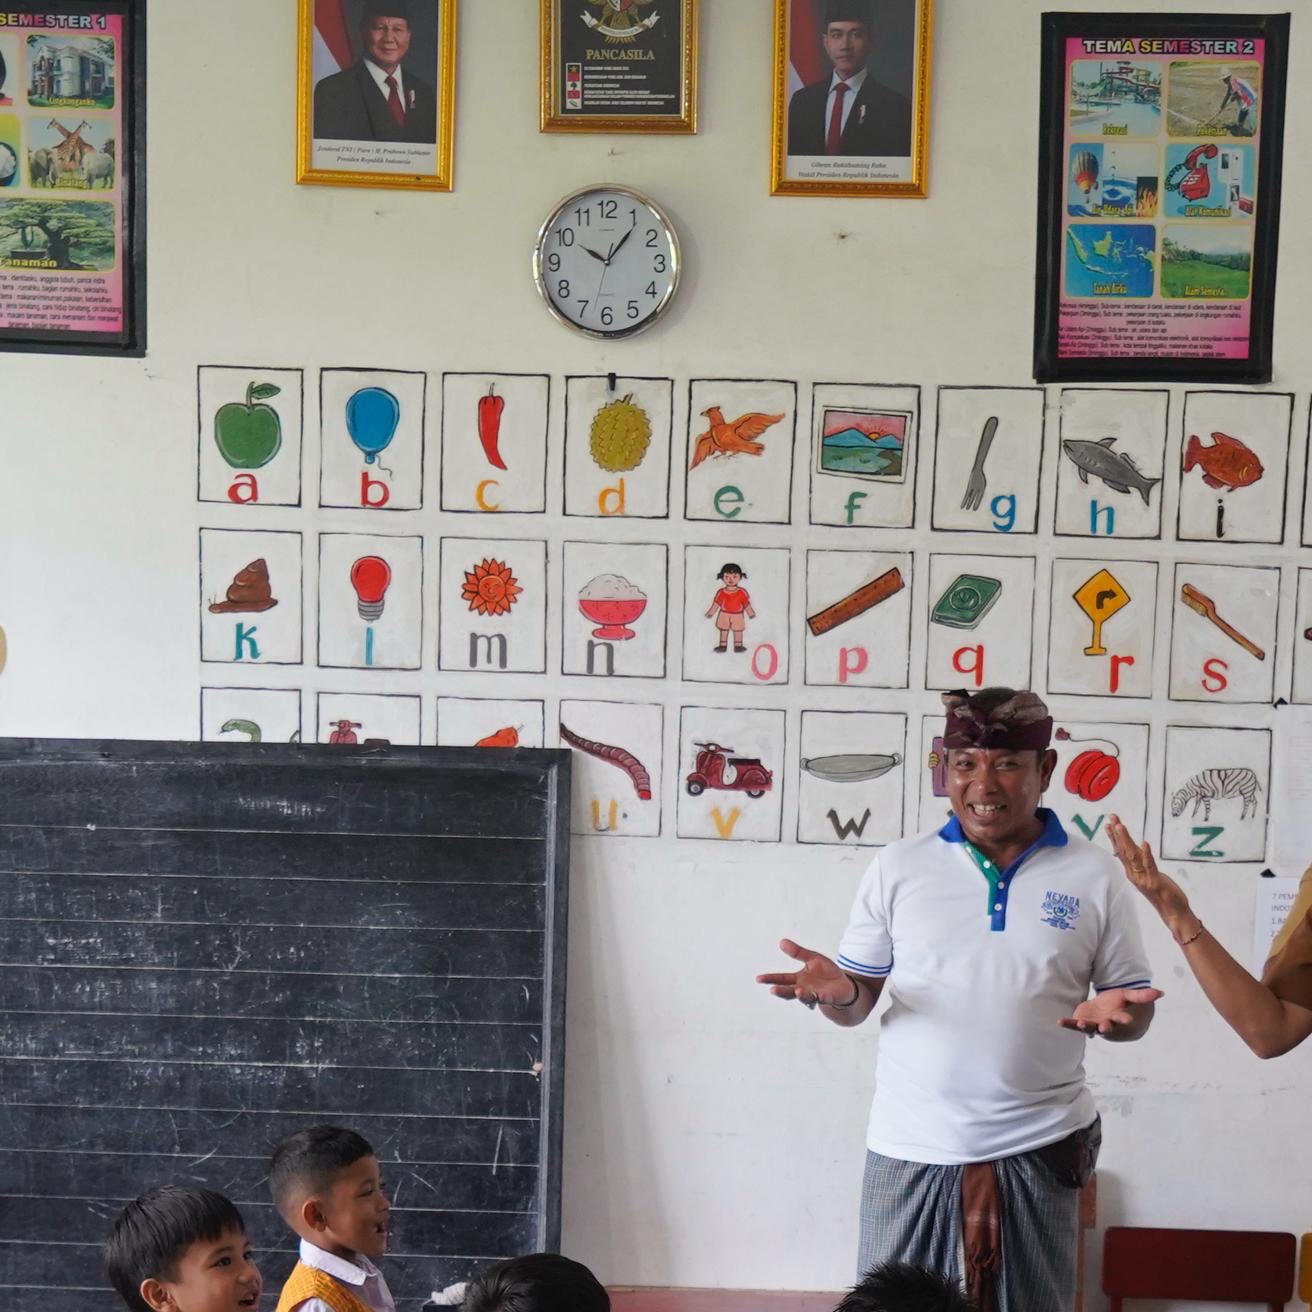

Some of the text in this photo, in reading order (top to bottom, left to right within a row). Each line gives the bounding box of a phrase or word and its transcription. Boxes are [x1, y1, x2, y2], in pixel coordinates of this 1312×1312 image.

[97, 16, 106, 29] 1
[586, 49, 655, 60] PANCASILA
[1083, 40, 1255, 54] TEMA SEMESTER 2
[574, 208, 590, 226] 11
[597, 200, 618, 219] 12
[629, 208, 637, 227] 1
[555, 227, 575, 247] 10
[645, 229, 658, 248] 2
[548, 253, 561, 272] 9
[653, 254, 666, 273] 3
[558, 279, 570, 299] 8
[645, 281, 658, 299] 4
[577, 300, 589, 319] 7
[601, 306, 613, 326] 6
[627, 300, 639, 319] 5
[227, 472, 259, 505] a
[361, 472, 388, 508] b
[476, 479, 500, 512] c
[598, 477, 626, 516] d
[713, 485, 745, 518] e
[844, 491, 868, 525] f
[990, 493, 1016, 532] g
[1090, 500, 1115, 534] h
[1216, 499, 1226, 538] i
[469, 631, 508, 669] m
[586, 638, 615, 677] n
[839, 645, 868, 684] p
[952, 643, 984, 687] q
[1110, 653, 1135, 694] r
[1202, 657, 1228, 693] s
[592, 799, 618, 832] u
[710, 806, 741, 839] v
[1045, 890, 1080, 908] NEVADA
